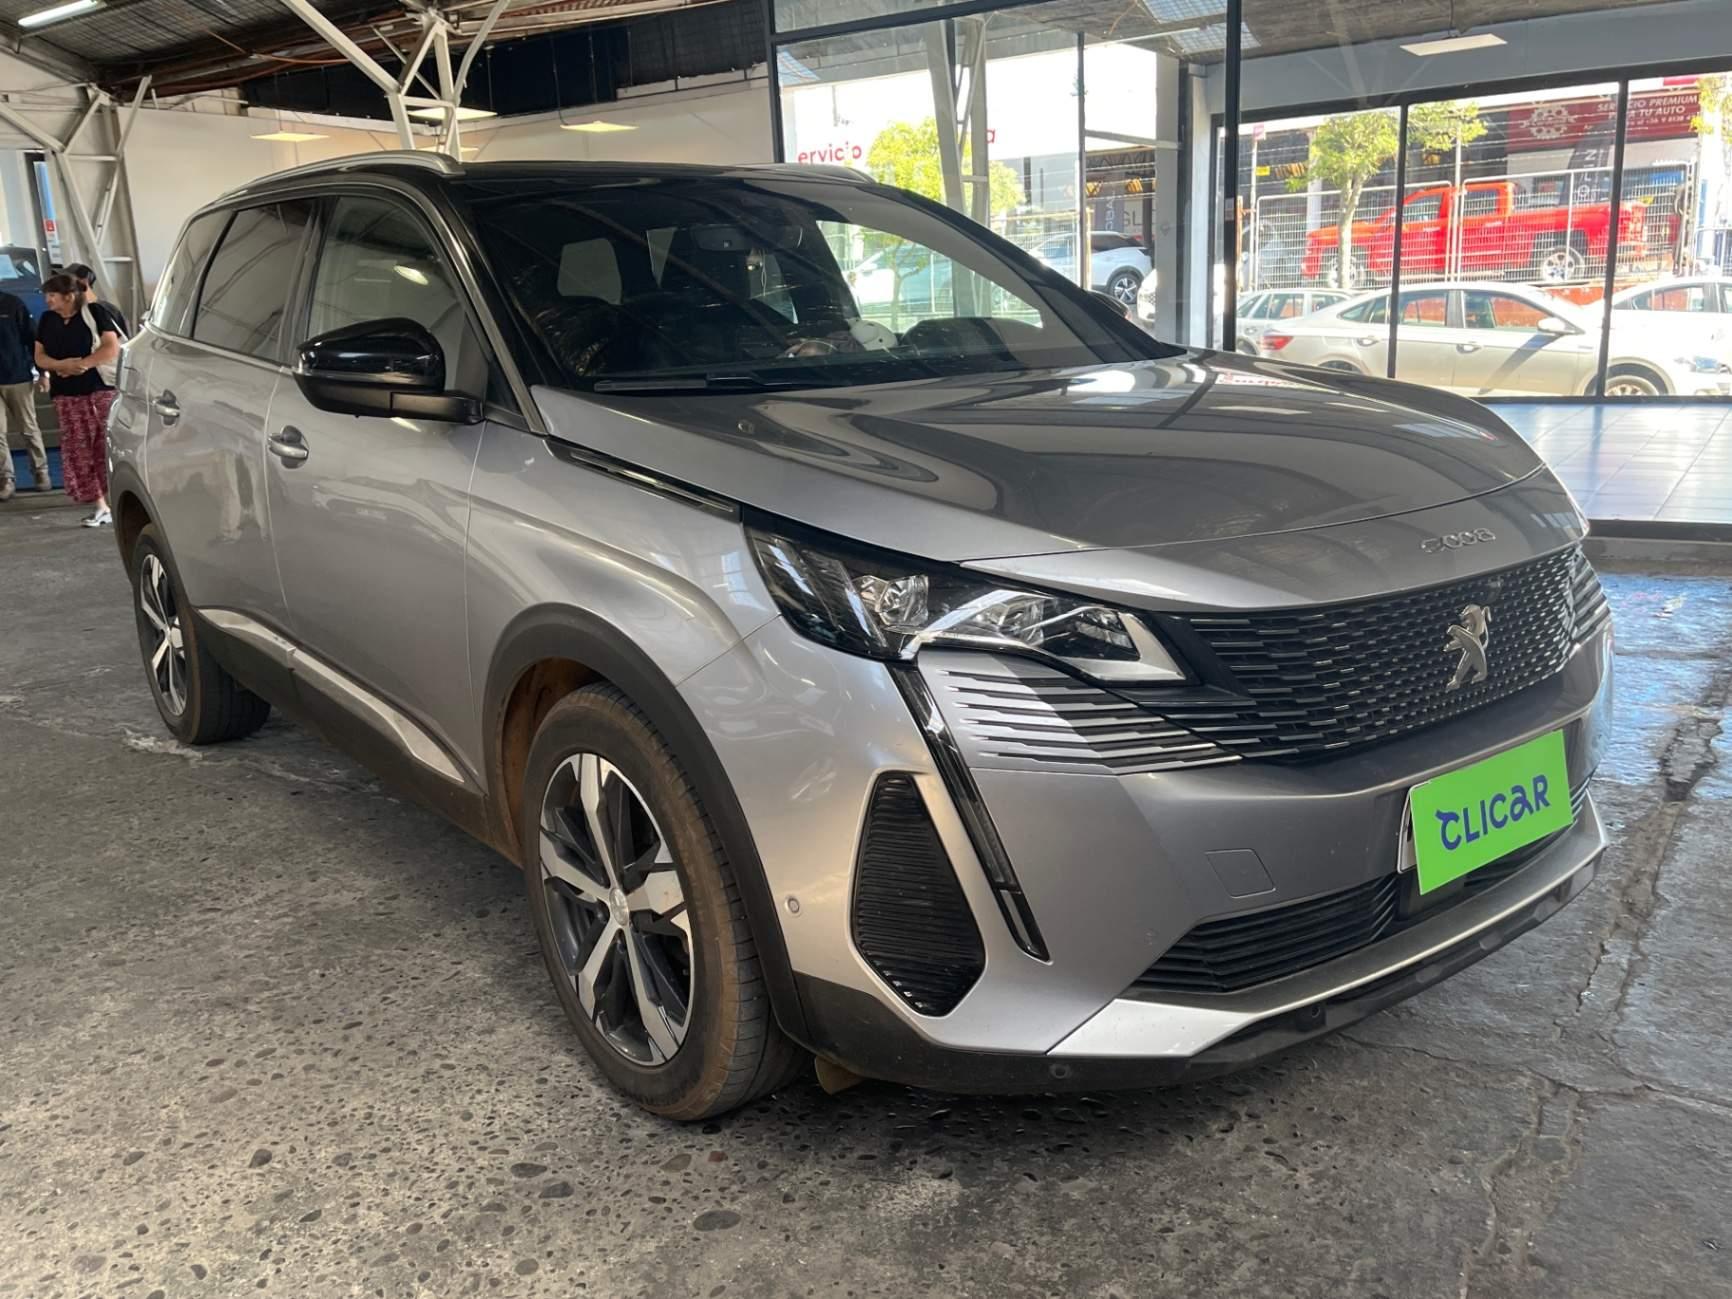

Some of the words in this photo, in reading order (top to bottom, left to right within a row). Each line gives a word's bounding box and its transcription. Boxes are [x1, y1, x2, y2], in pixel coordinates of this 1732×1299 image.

[1597, 101, 1646, 112] SERCIO
[1649, 95, 1697, 107] PREMIUM
[1655, 106, 1685, 115] AUTO
